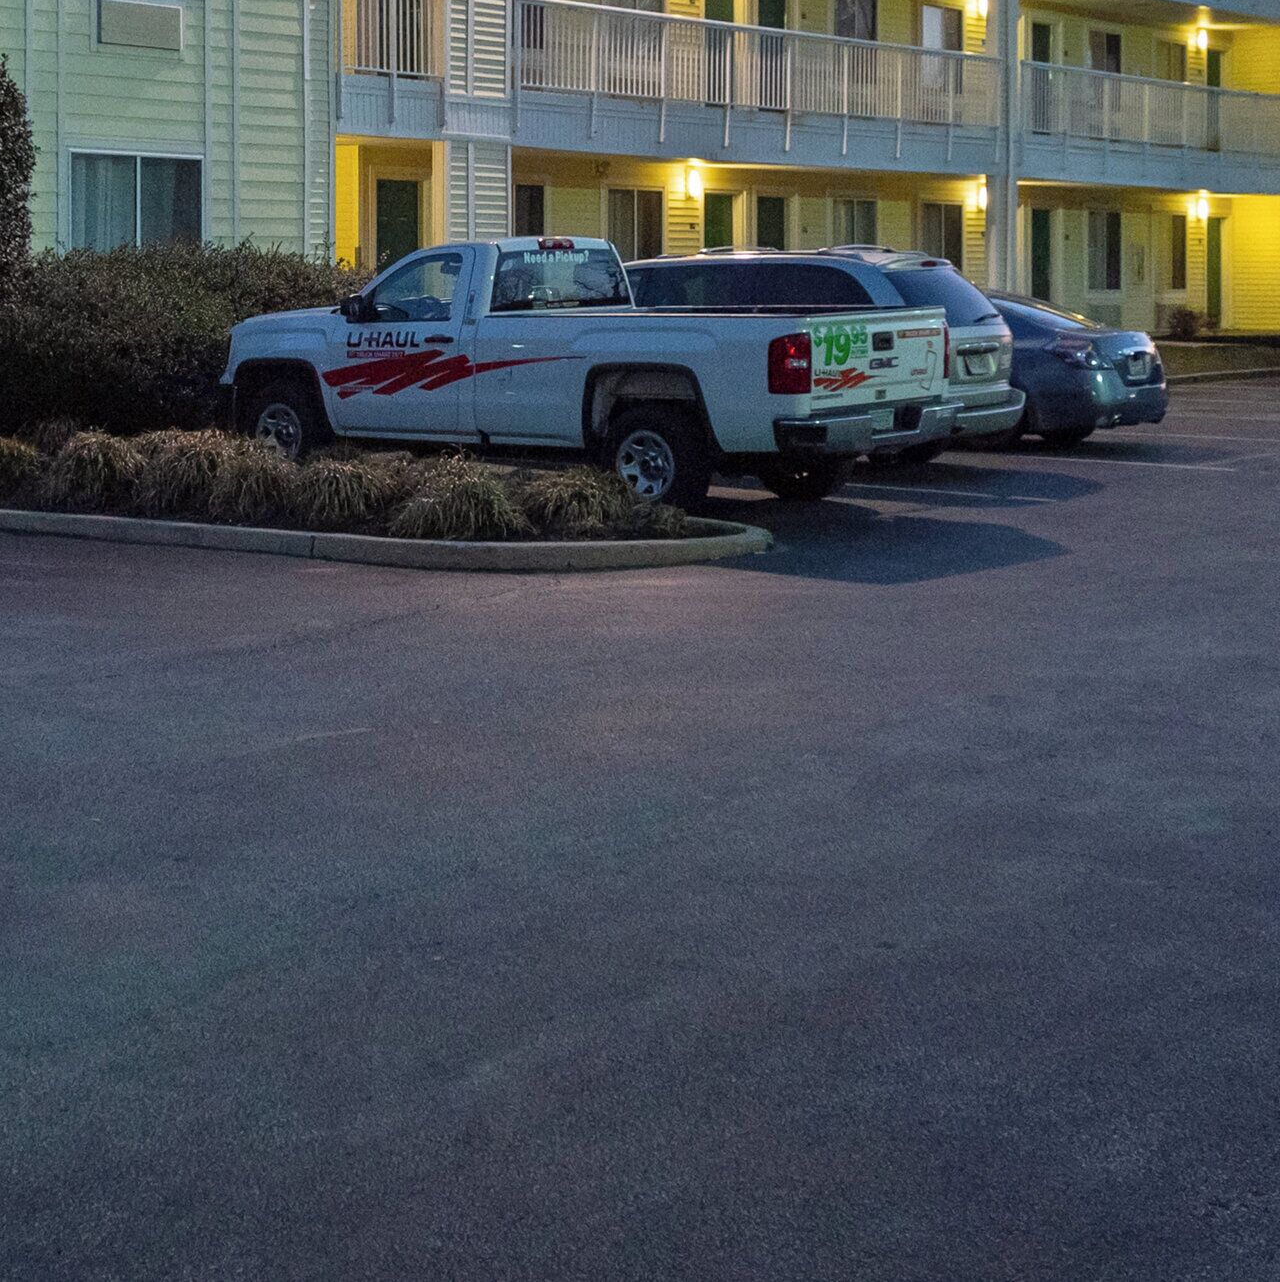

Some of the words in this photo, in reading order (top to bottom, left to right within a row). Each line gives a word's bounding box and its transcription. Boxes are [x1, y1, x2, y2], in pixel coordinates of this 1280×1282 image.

[524, 250, 547, 264] Need
[549, 253, 554, 263] a
[555, 249, 589, 265] Pickup?
[346, 331, 420, 348] U-HAUL
[869, 357, 899, 370] GMC
